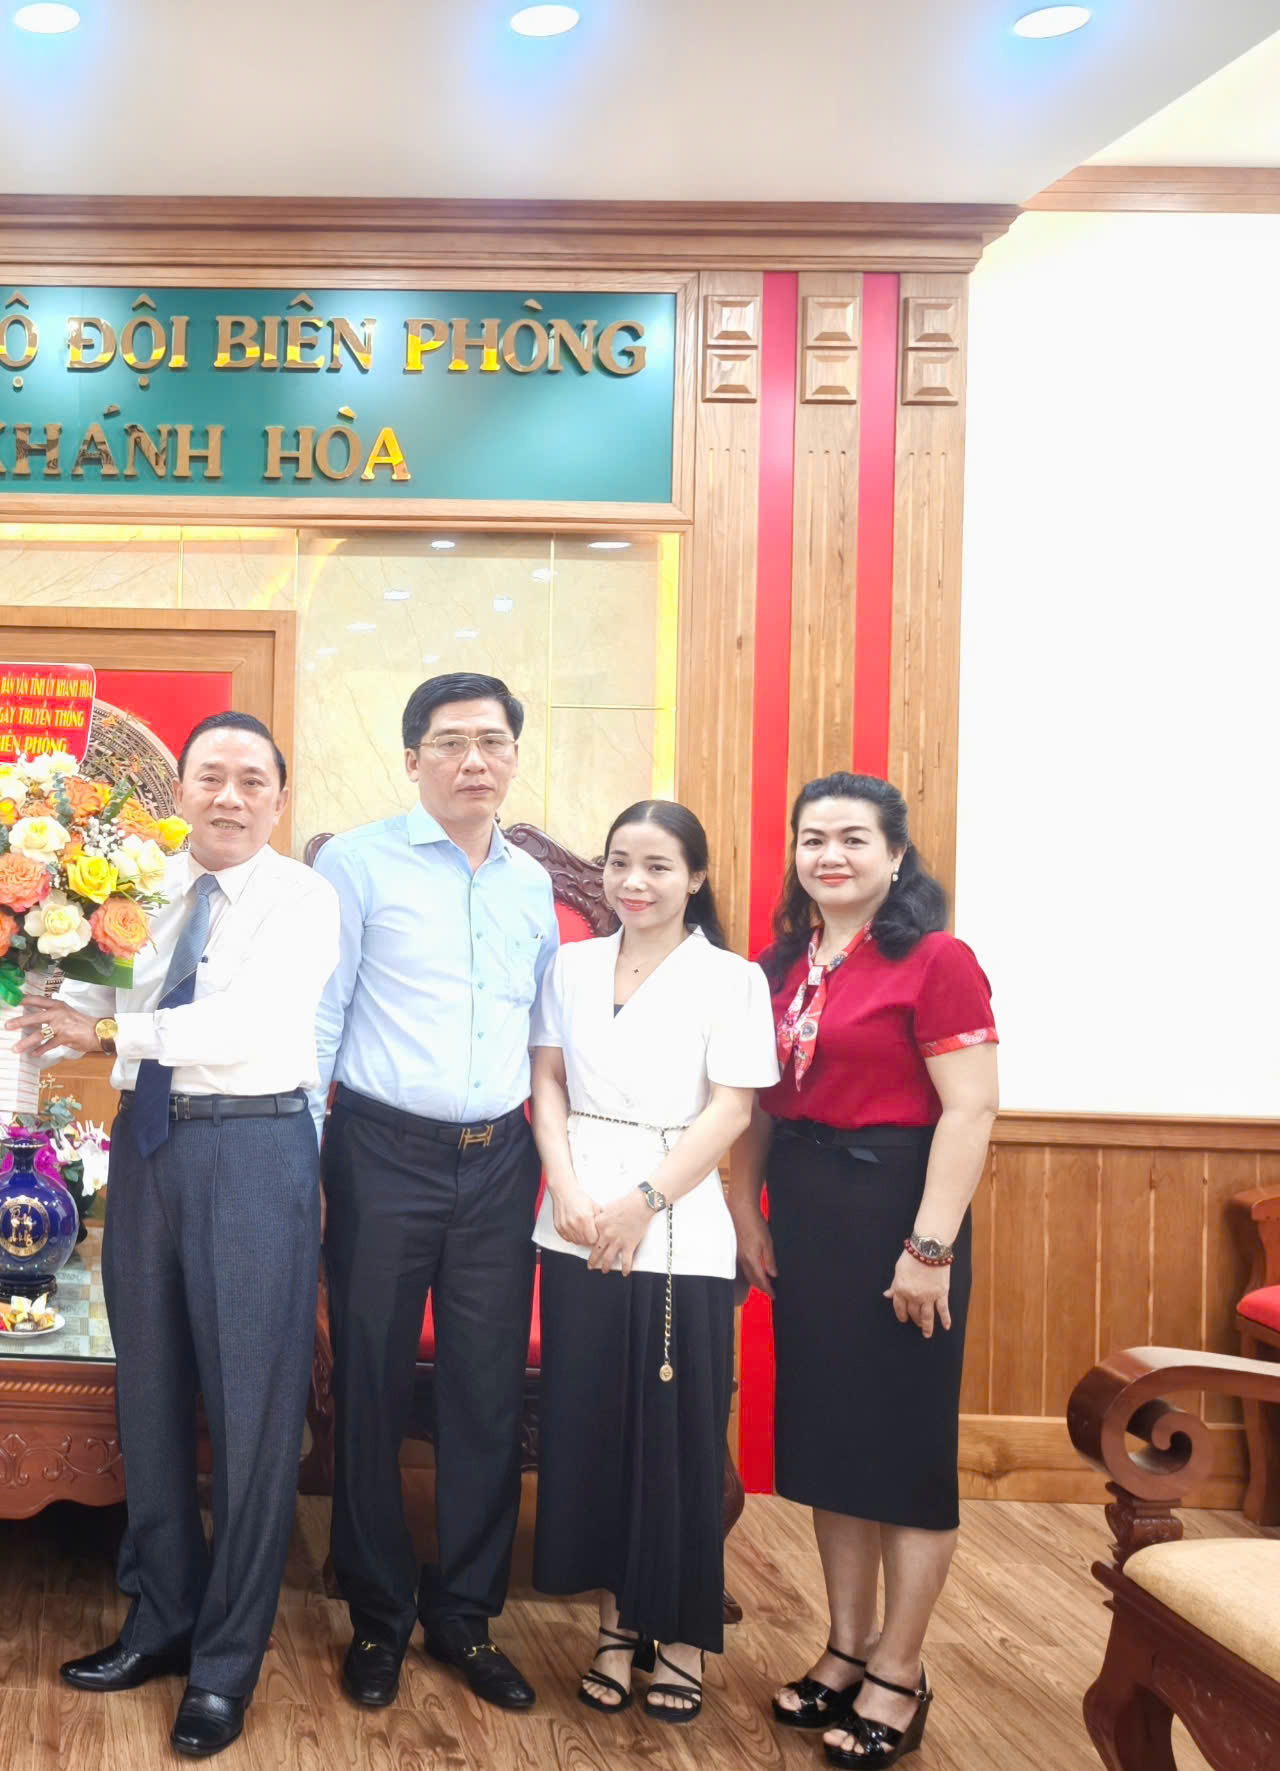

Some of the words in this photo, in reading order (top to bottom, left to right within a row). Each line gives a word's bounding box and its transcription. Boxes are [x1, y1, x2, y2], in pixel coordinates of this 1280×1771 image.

[66, 292, 188, 388] ĐỘI
[214, 292, 376, 370] BIÊN
[404, 298, 647, 376] PHÒNG
[263, 406, 411, 480] HÒA
[19, 700, 51, 726] TRUYỀN
[54, 702, 84, 728] THỐNG
